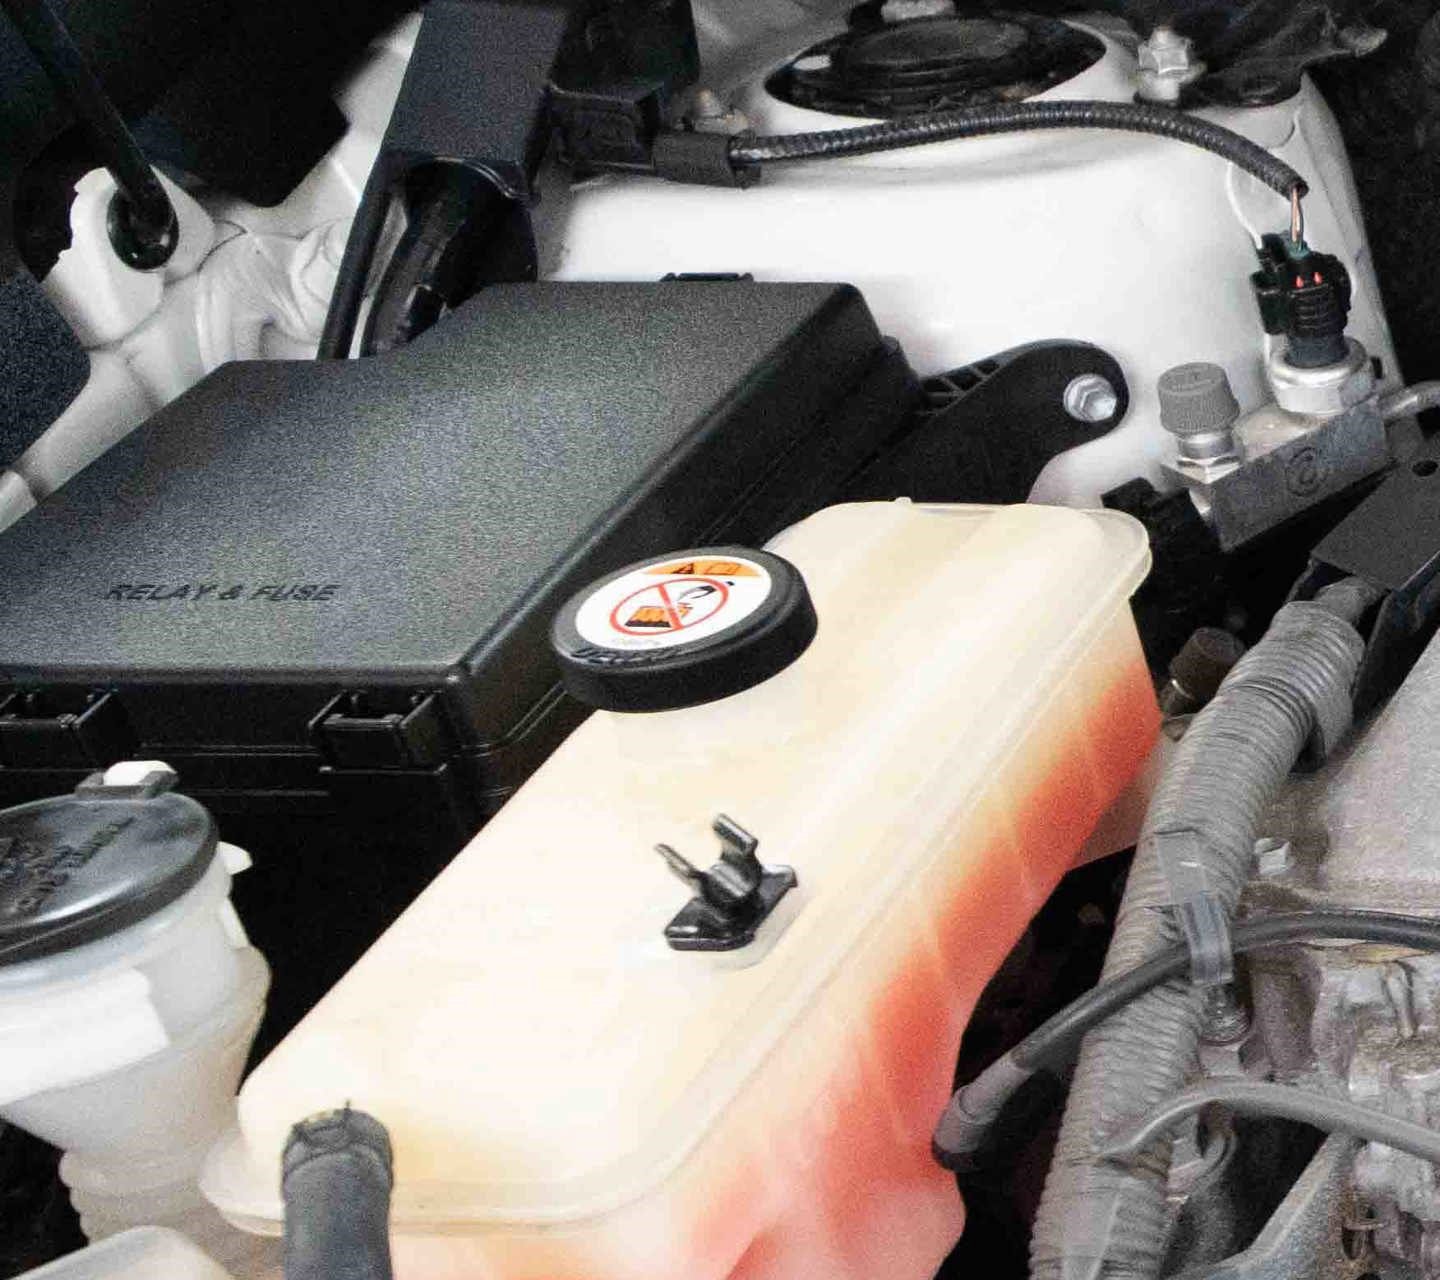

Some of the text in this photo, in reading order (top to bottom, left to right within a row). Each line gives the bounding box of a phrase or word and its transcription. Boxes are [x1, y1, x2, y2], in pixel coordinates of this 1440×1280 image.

[104, 584, 342, 602] RELAY & FUSE
